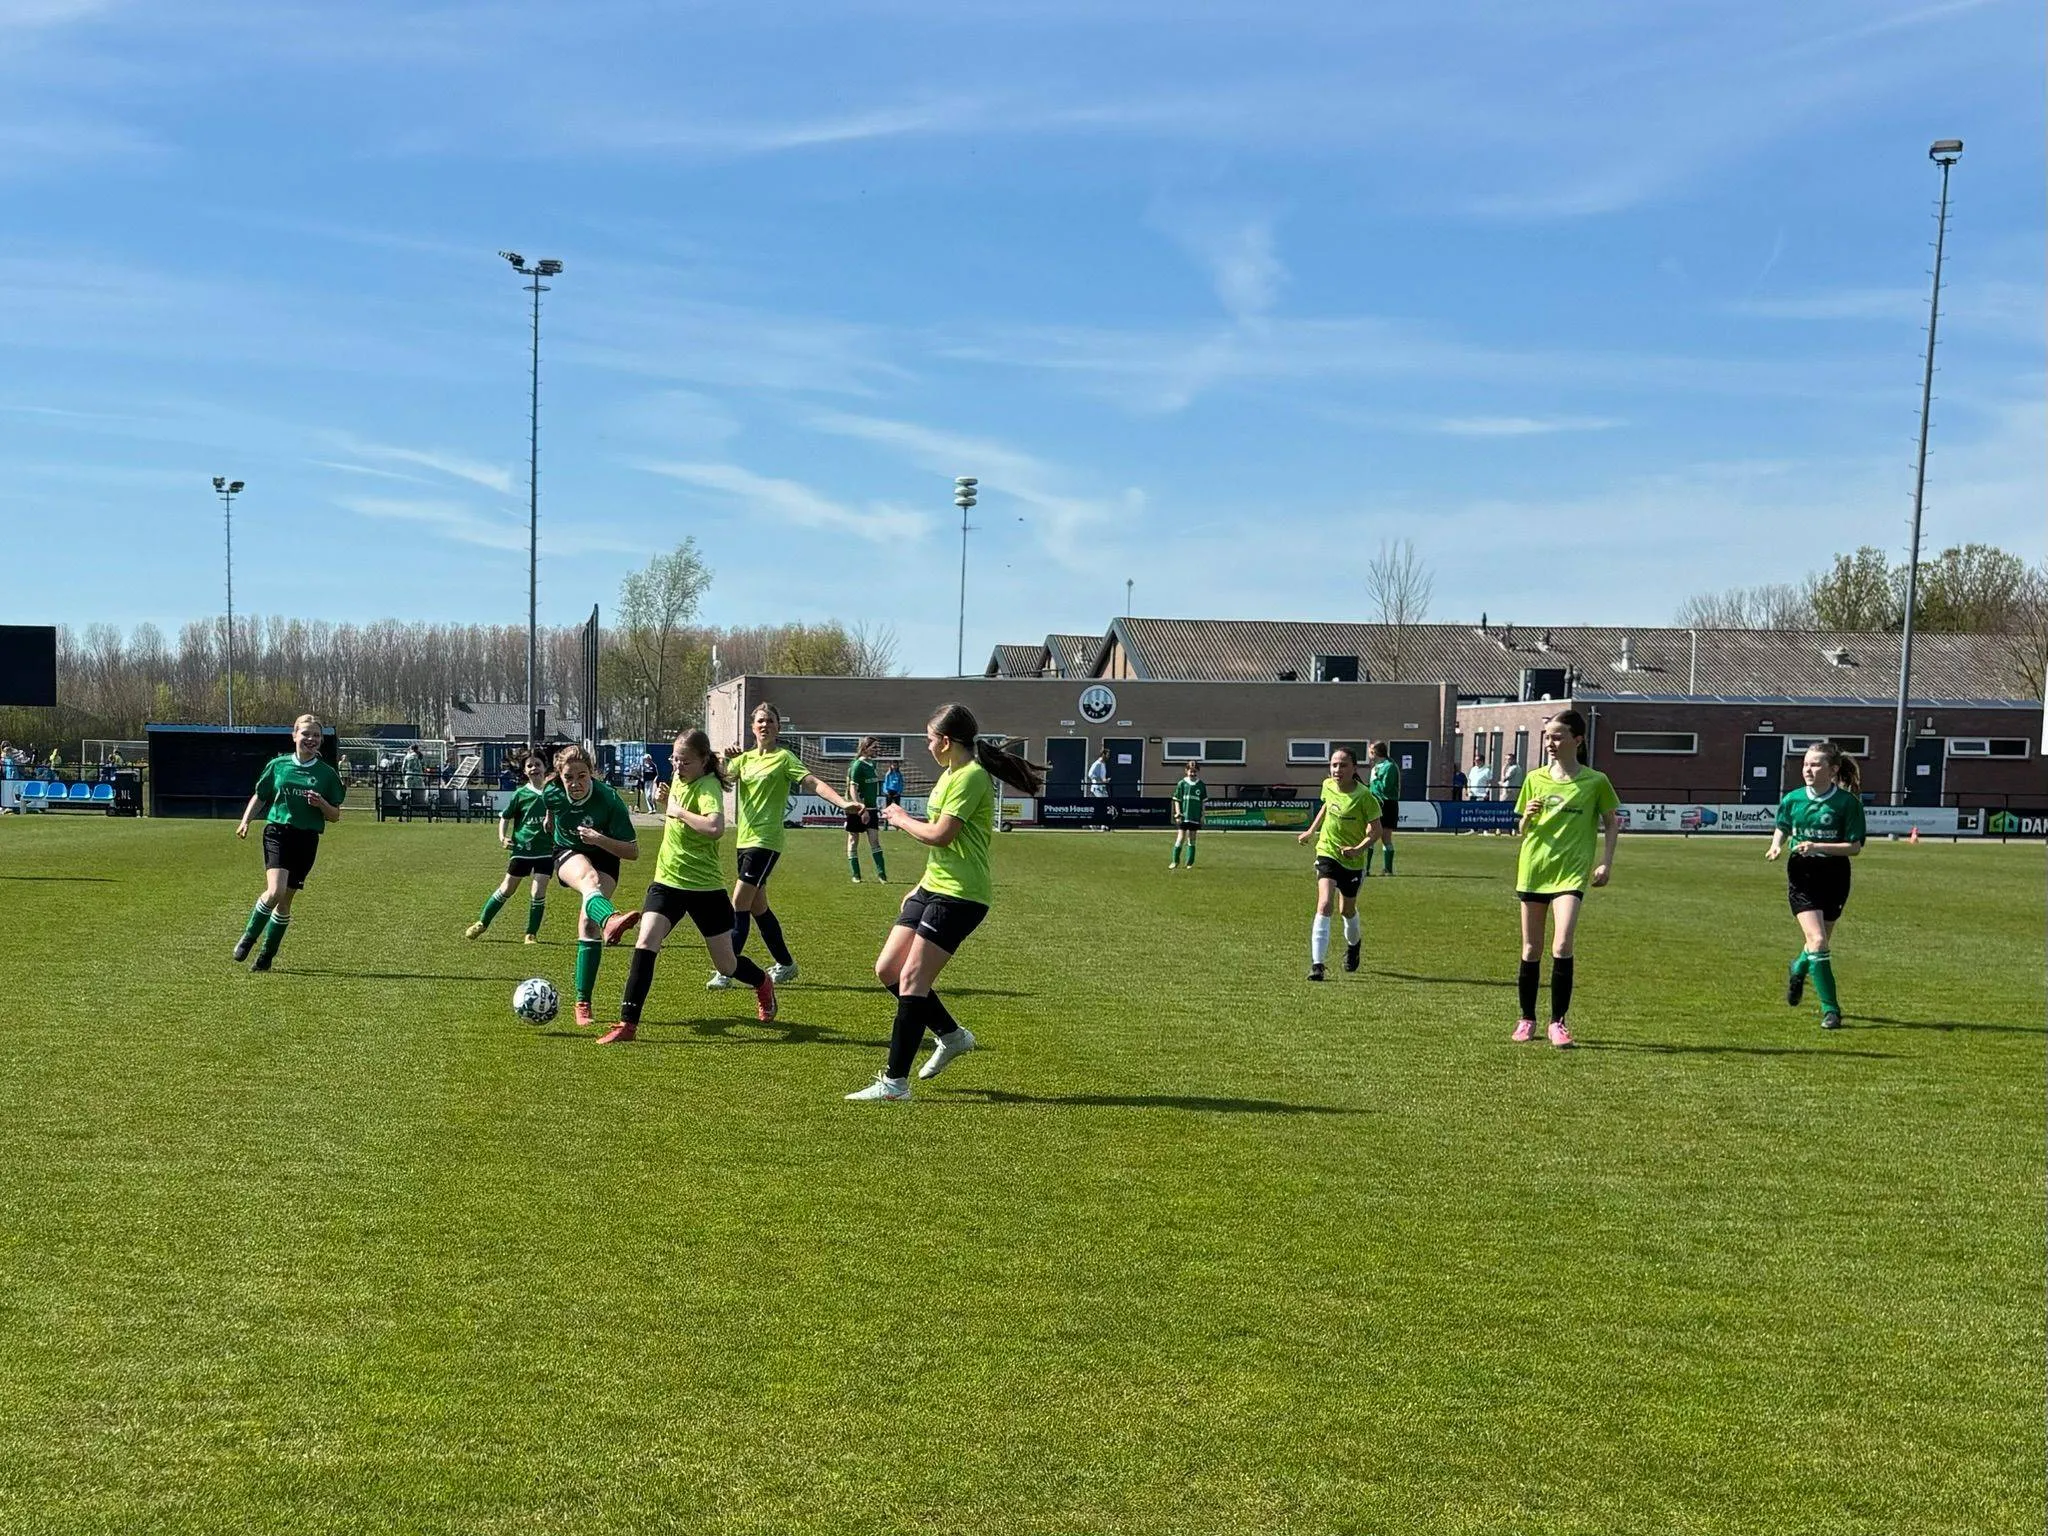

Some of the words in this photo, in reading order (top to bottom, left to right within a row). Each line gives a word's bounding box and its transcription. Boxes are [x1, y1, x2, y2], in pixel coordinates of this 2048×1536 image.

[803, 805, 828, 816] JAN
[1044, 805, 1069, 813] Phone
[1070, 805, 1095, 813] House
